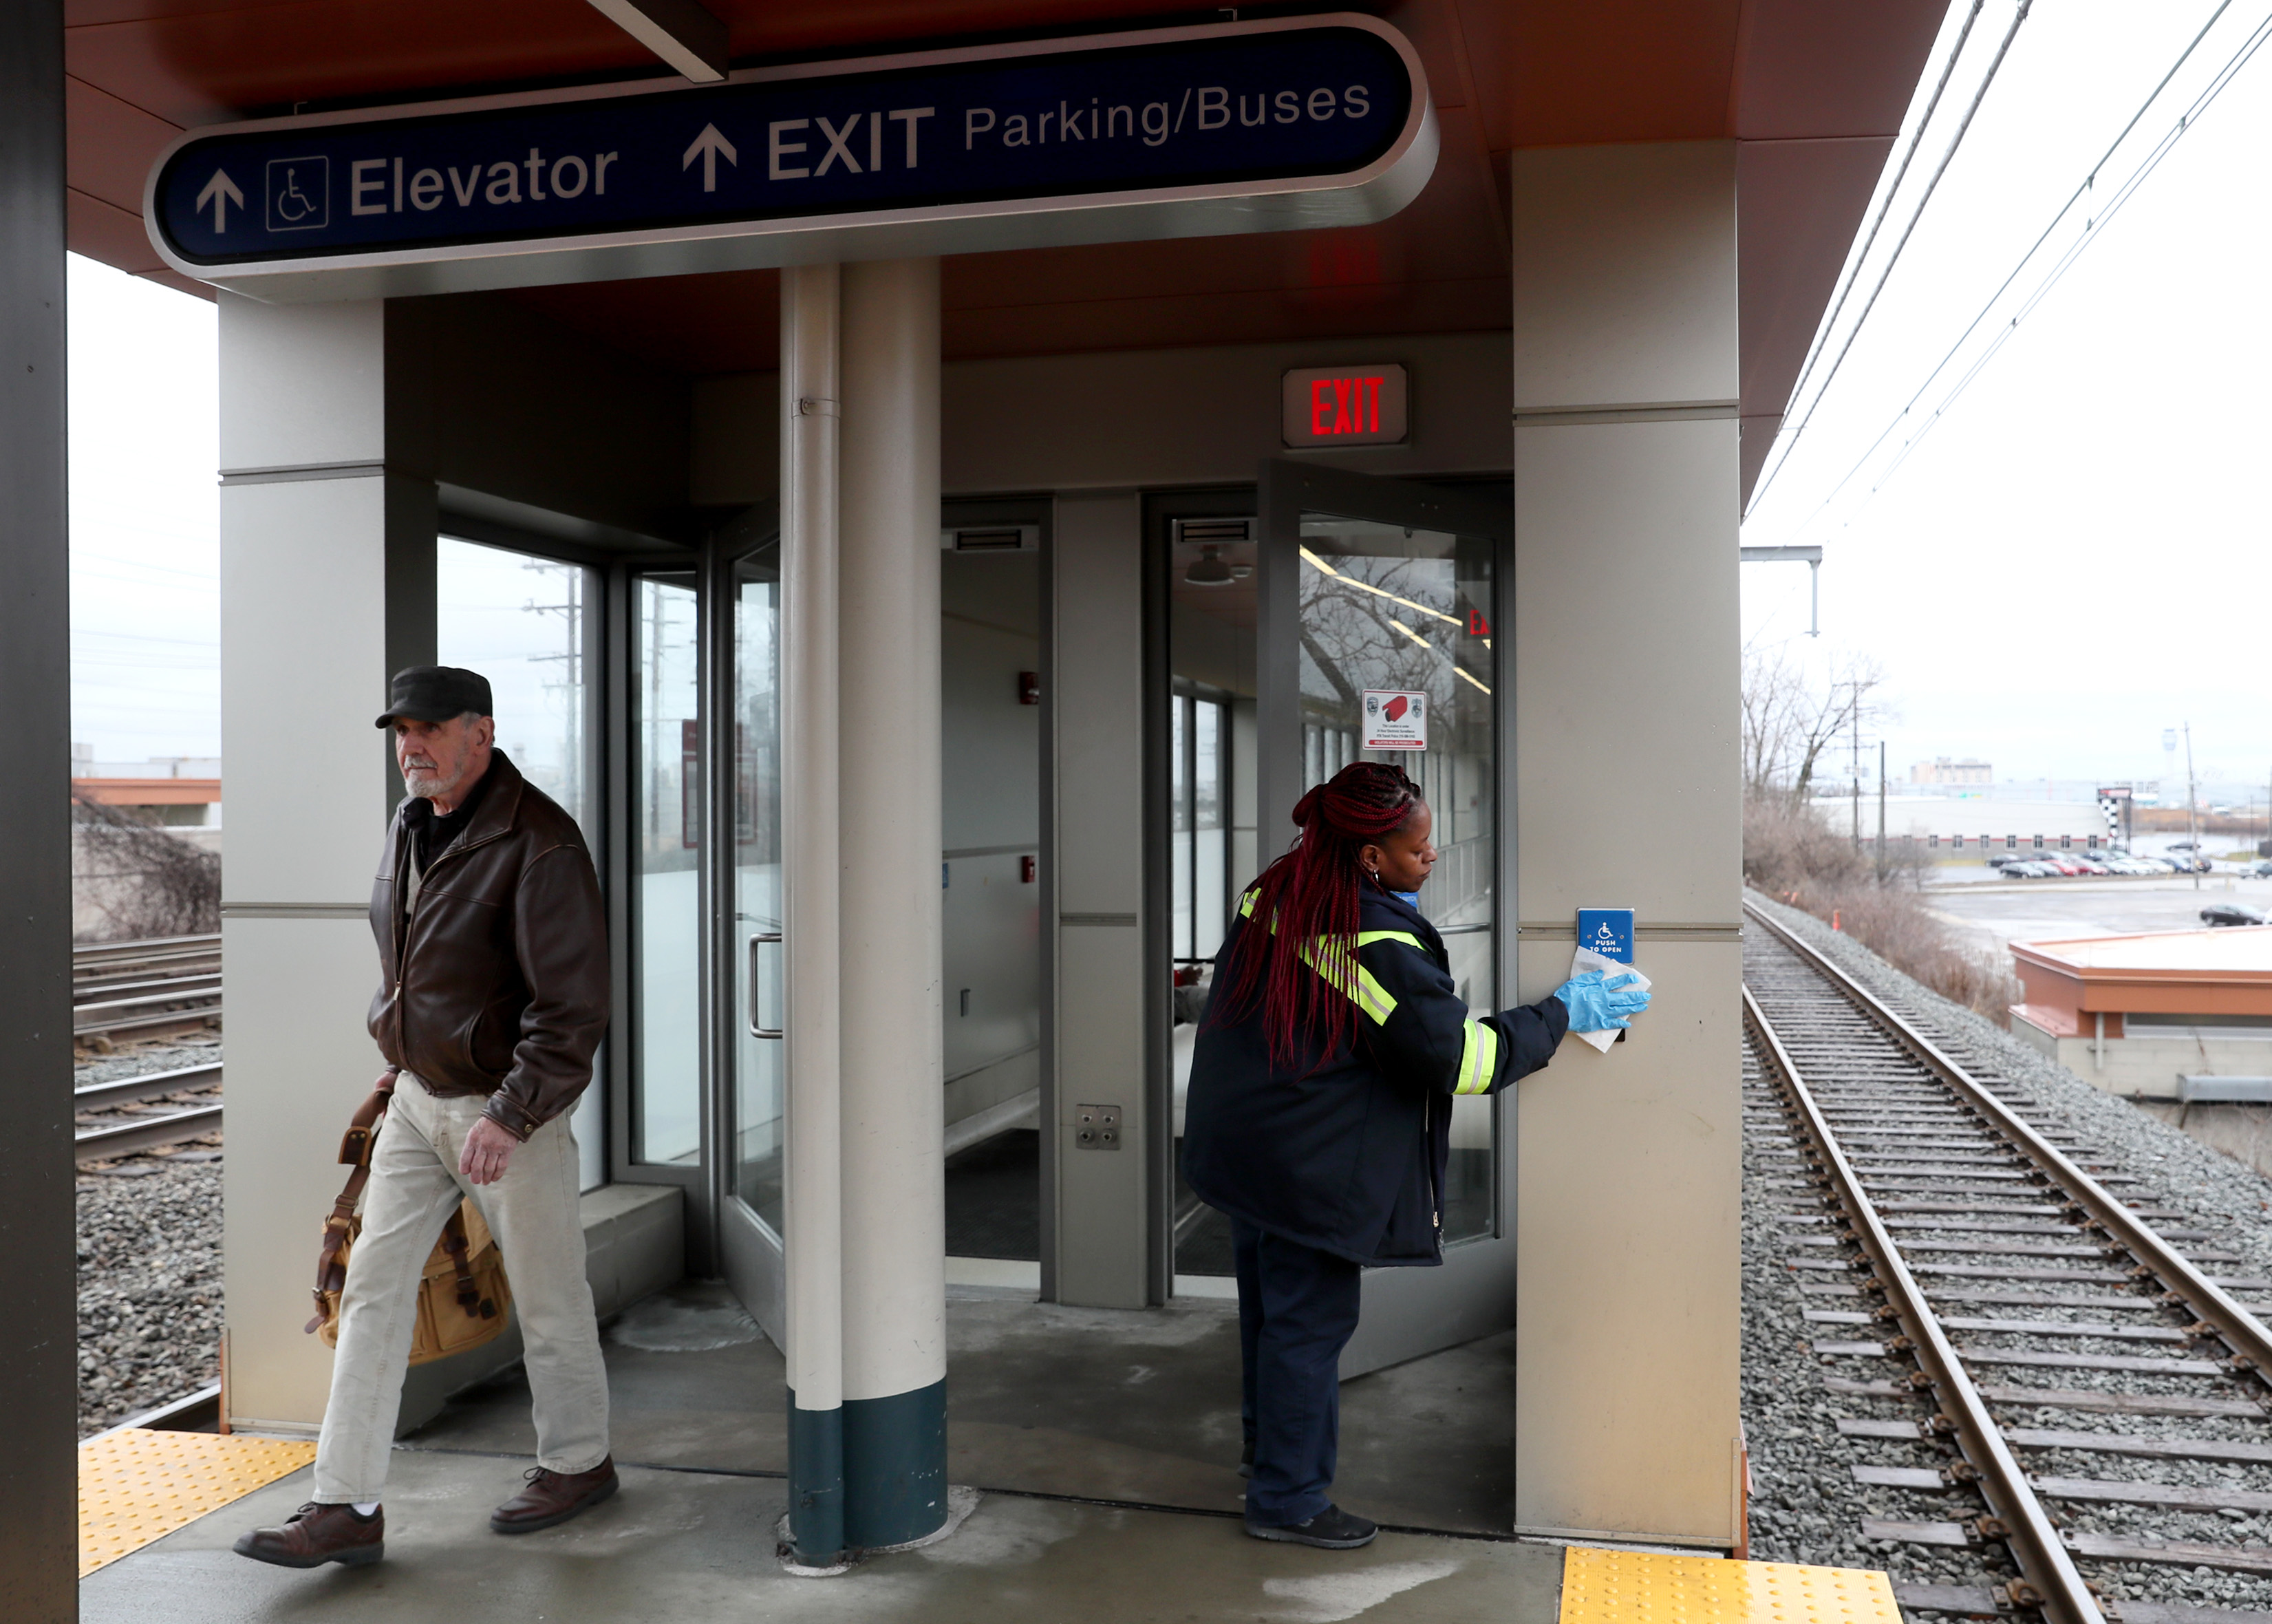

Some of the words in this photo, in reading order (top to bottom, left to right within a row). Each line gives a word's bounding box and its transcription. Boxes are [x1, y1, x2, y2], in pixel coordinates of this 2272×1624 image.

[351, 148, 618, 216] Elevator
[768, 107, 935, 182] EXIT
[965, 84, 1371, 150] Parking/Buses
[1311, 376, 1384, 436] EXIT
